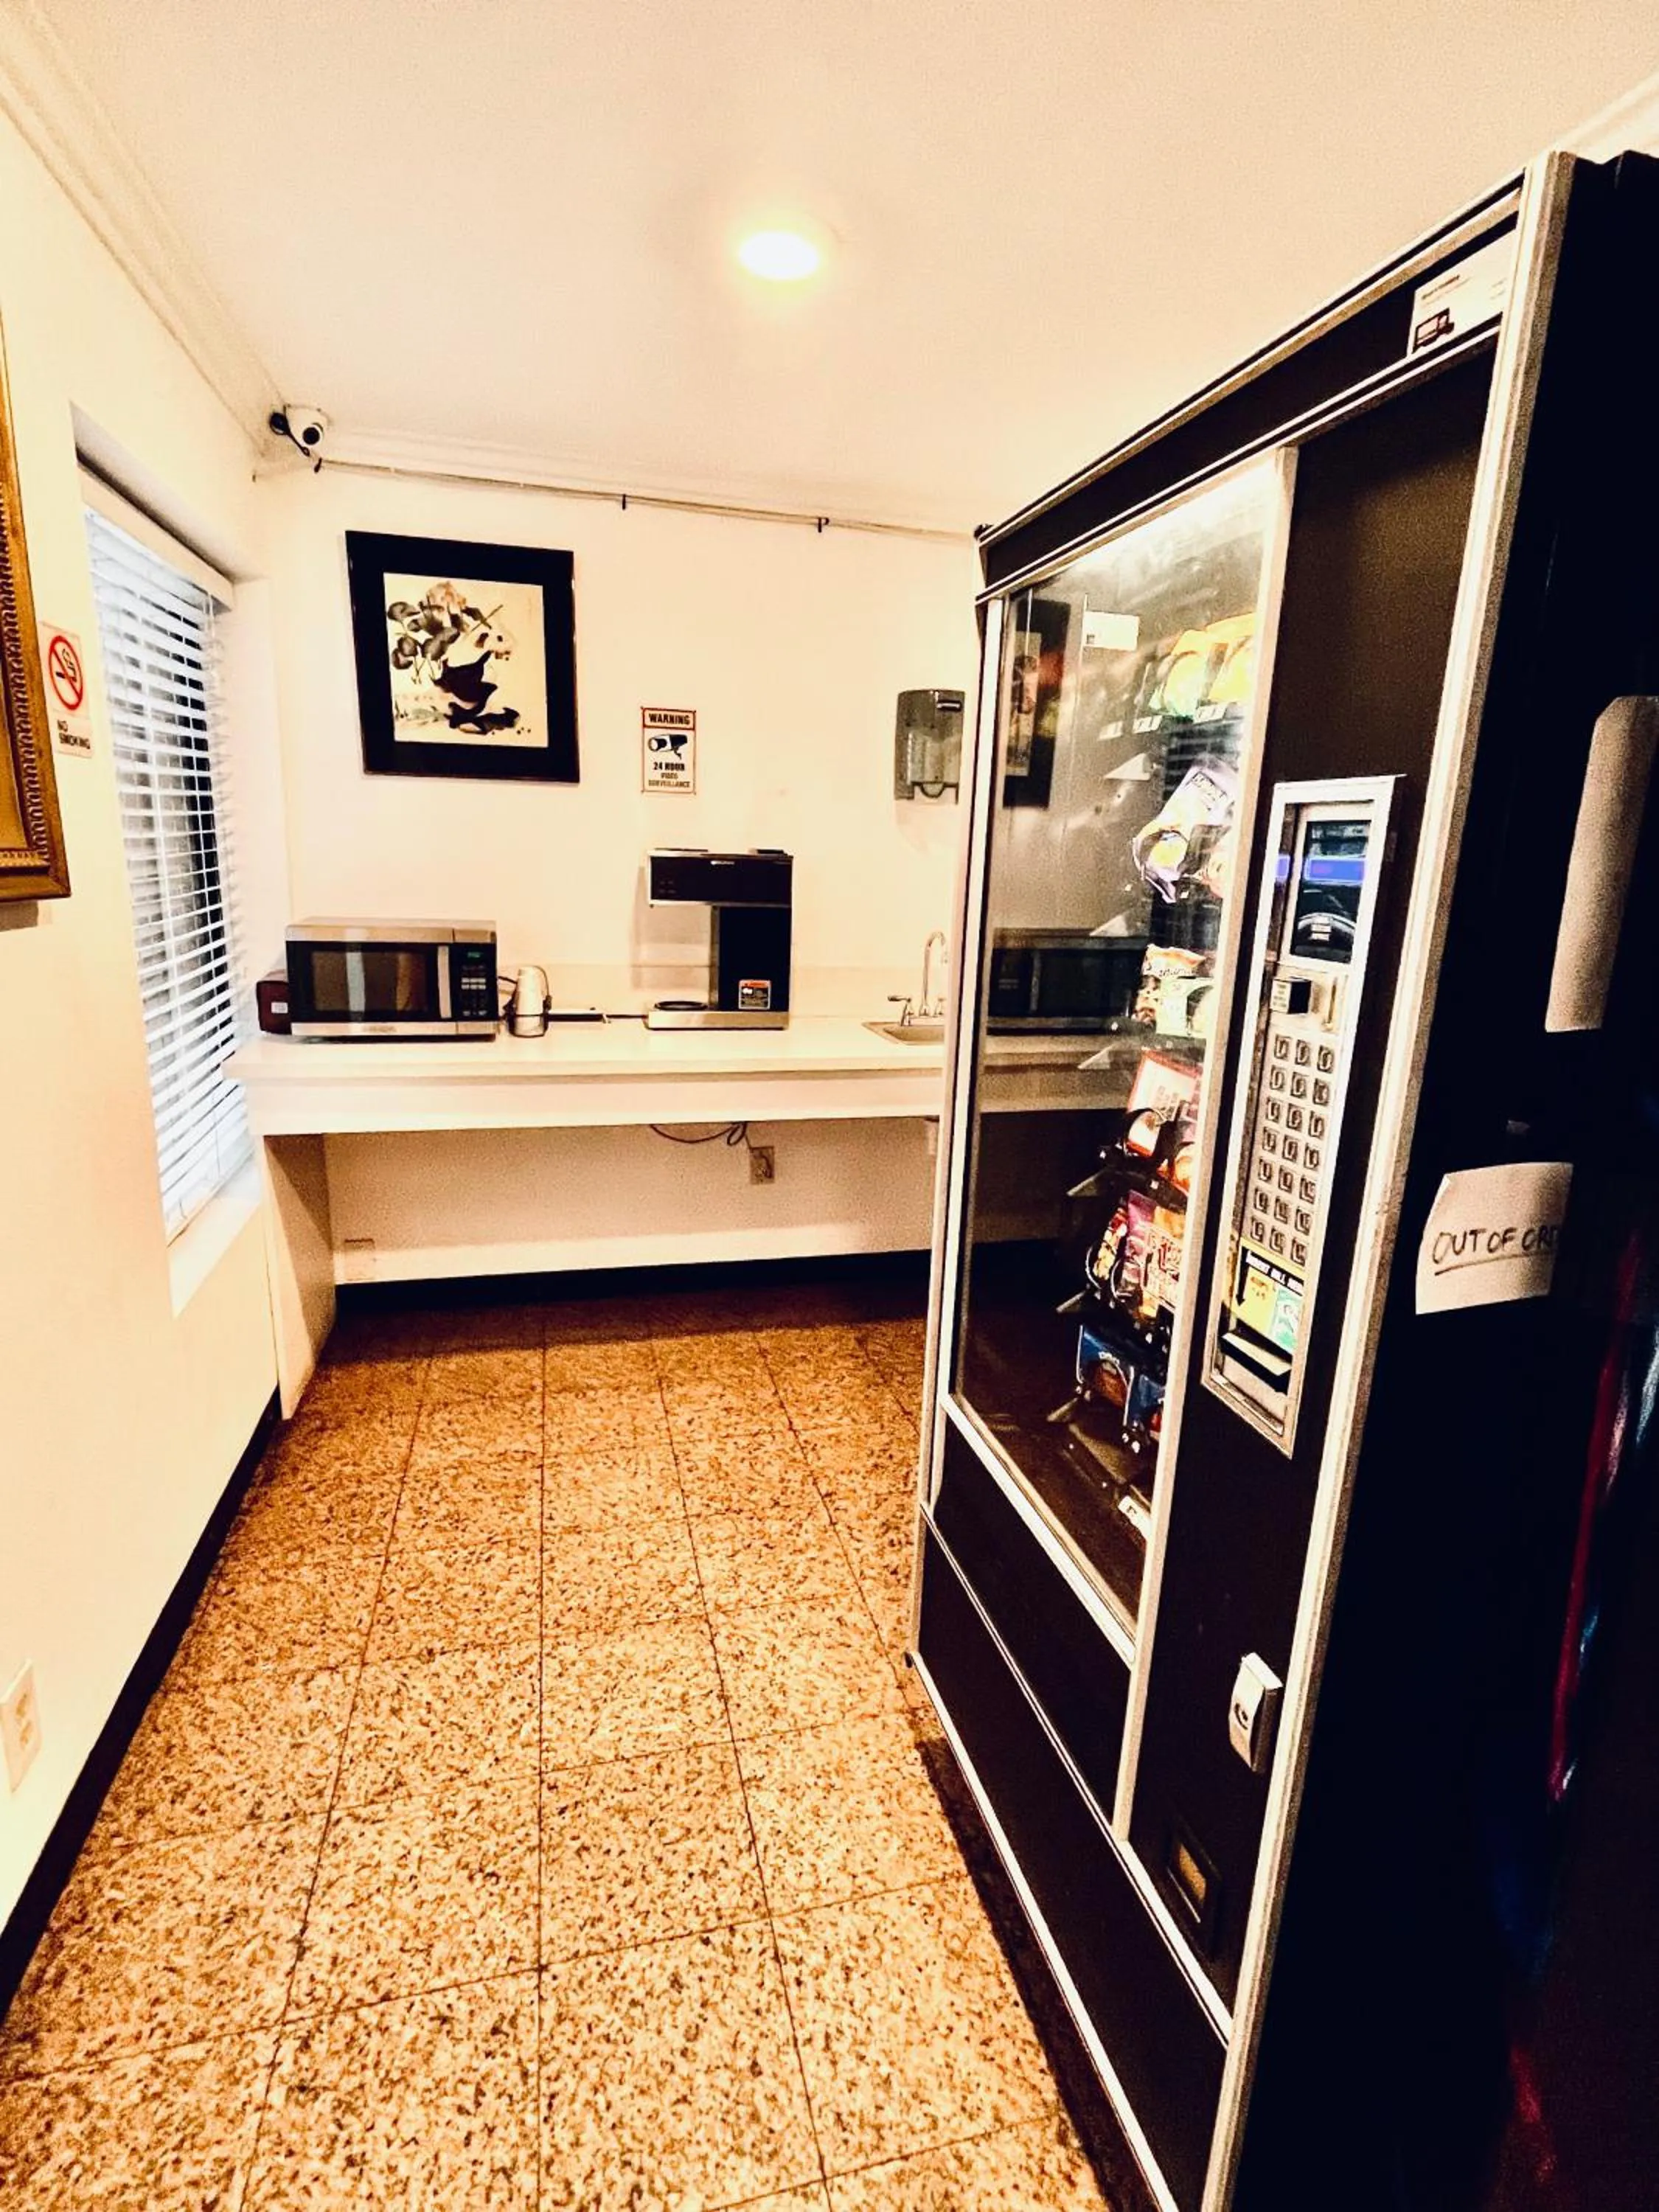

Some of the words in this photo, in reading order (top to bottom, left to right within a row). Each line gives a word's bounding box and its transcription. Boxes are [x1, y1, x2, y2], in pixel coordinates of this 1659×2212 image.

[648, 712, 690, 725] WARNING
[653, 762, 663, 771] 24
[664, 762, 685, 771] HOUR
[1432, 1228, 1486, 1264] OUT
[1487, 1227, 1517, 1253] OF
